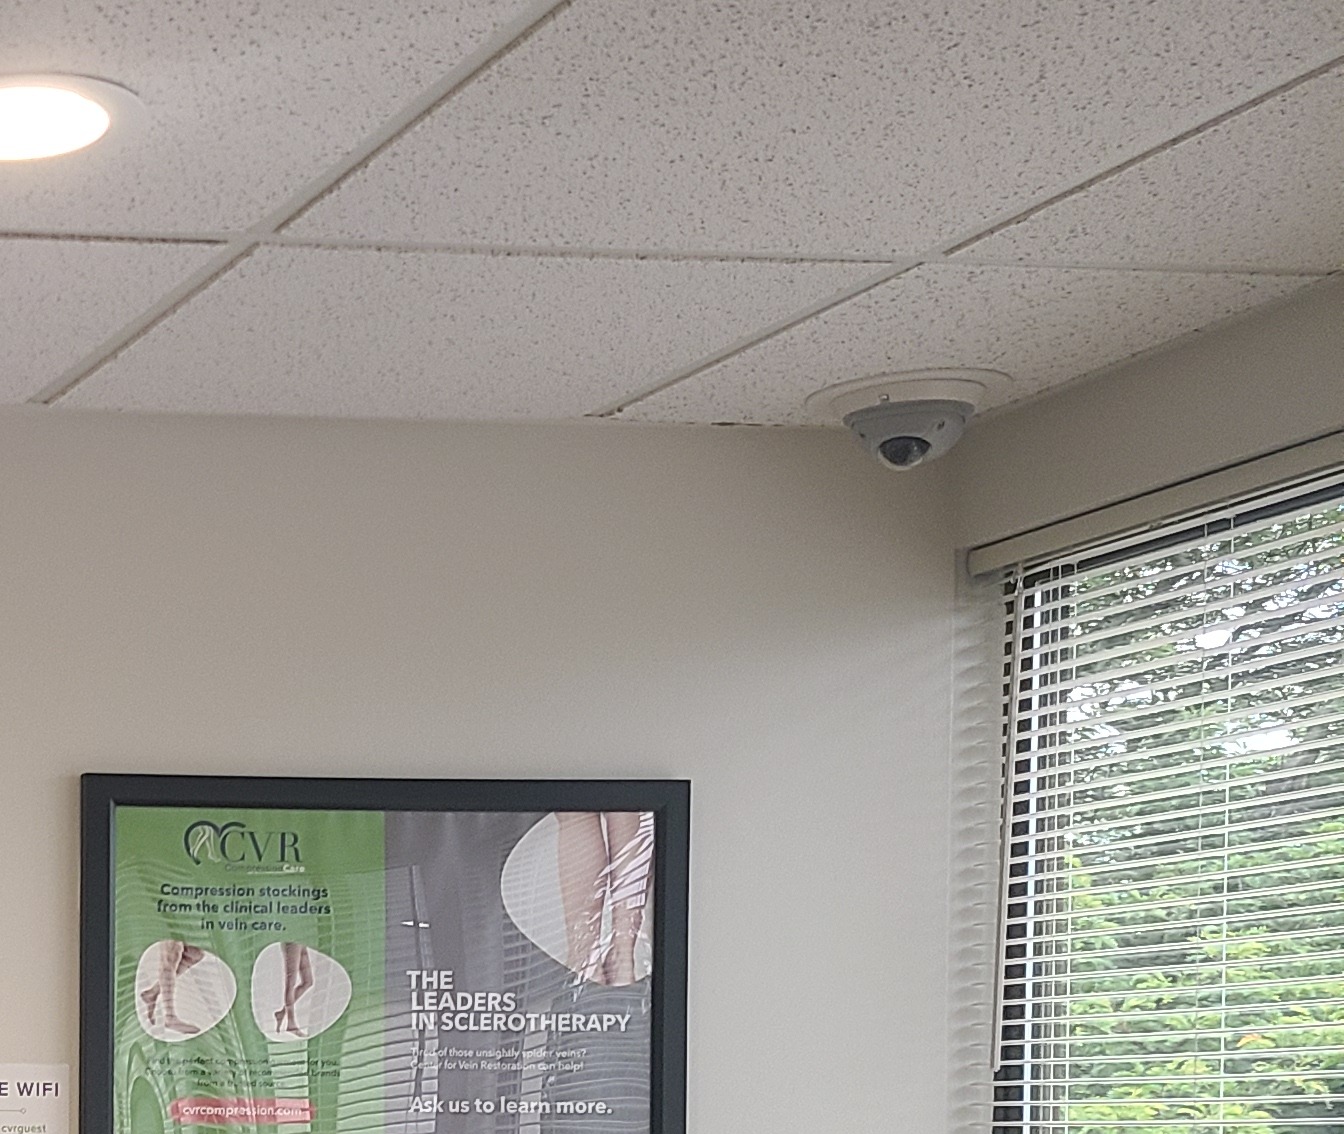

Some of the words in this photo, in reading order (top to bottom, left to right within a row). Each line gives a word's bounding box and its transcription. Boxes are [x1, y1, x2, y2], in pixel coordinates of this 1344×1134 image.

[220, 830, 303, 863] CVR
[161, 884, 254, 899] Compression
[259, 884, 328, 900] stockings
[157, 900, 192, 913] from
[196, 901, 218, 913] the
[223, 901, 272, 914] clinical
[277, 902, 331, 915] leaders
[201, 919, 214, 930] in
[218, 920, 247, 931] vein
[252, 921, 286, 931] care.
[407, 970, 453, 990] THE
[412, 992, 516, 1012] LEADERS
[412, 1013, 434, 1030] IN
[441, 1013, 630, 1032] SCLEROTHERAPY
[17, 1082, 59, 1097] WIFI
[183, 1105, 302, 1117] cvrcompression.com
[411, 1098, 444, 1113] Ask
[449, 1101, 469, 1113] us
[476, 1100, 494, 1114] to
[500, 1097, 550, 1115] learn
[557, 1101, 613, 1115] more.
[1, 1125, 46, 1134] cvrguest
